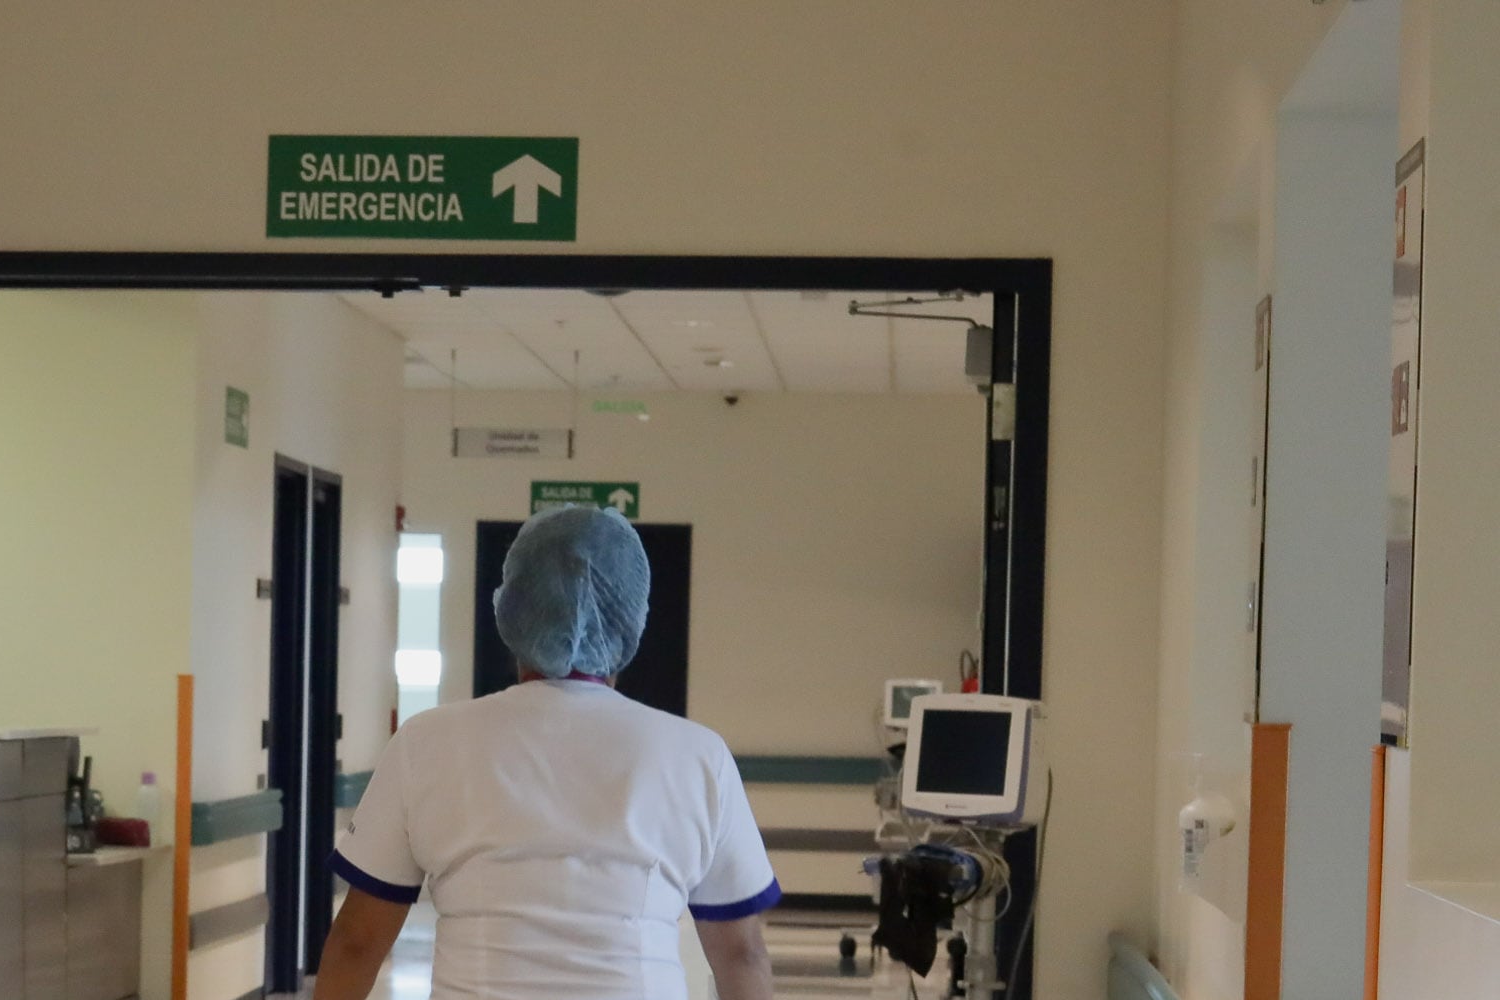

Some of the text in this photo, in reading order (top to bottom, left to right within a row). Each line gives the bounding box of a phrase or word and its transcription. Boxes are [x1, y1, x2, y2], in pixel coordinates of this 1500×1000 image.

[299, 152, 445, 184] SALIDA DE
[279, 191, 464, 222] EMERGENCIA
[541, 487, 593, 498] SALIDA DE
